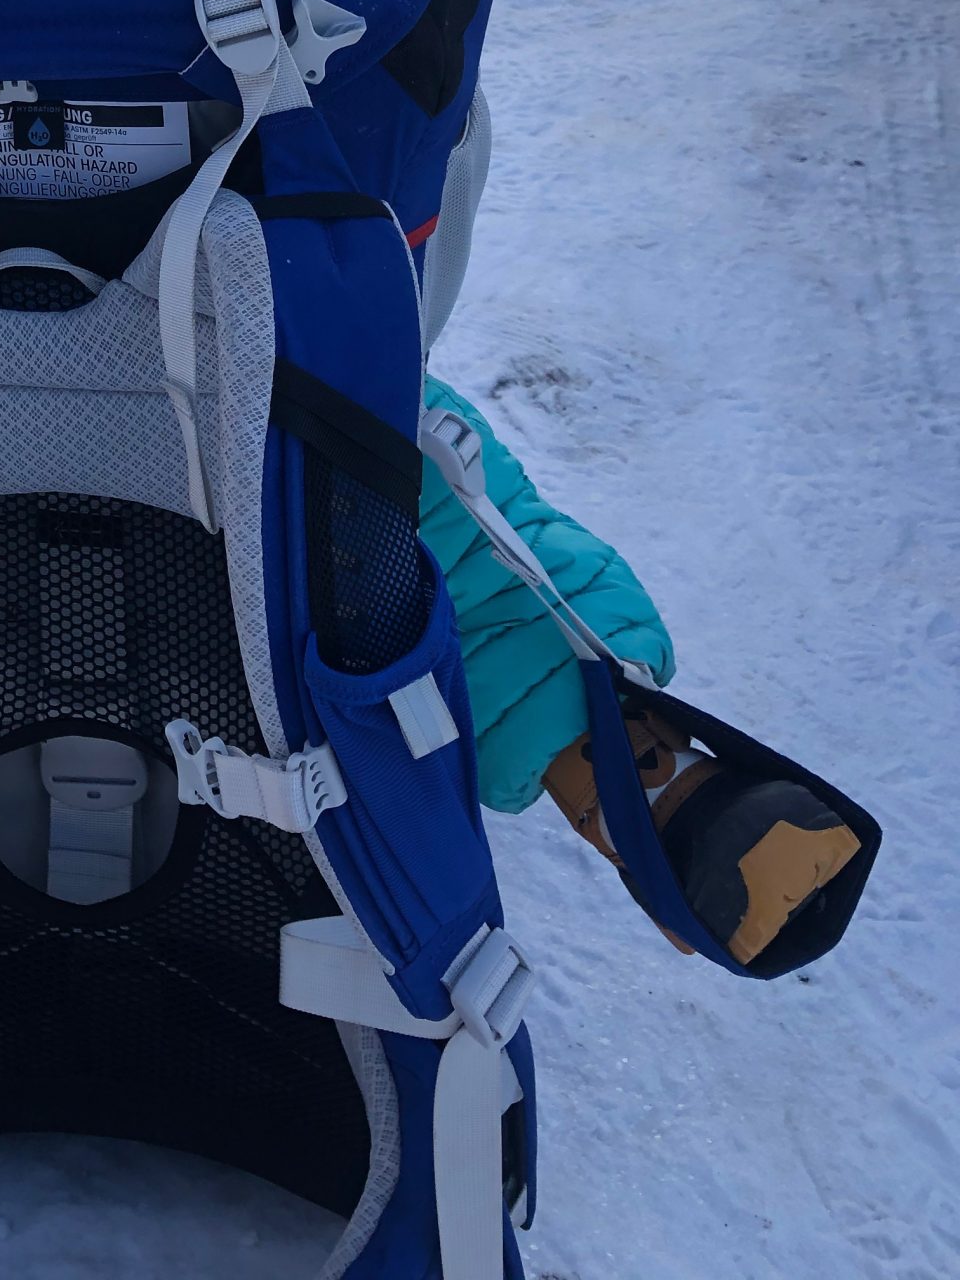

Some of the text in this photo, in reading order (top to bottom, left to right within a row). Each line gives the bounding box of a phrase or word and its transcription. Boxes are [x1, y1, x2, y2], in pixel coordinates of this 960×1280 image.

[16, 104, 62, 113] HYDRATION
[71, 125, 89, 134] ASTM
[84, 144, 104, 158] OR
[81, 158, 138, 175] HAZARD
[53, 169, 88, 185] FALL-
[91, 173, 130, 189] ODER
